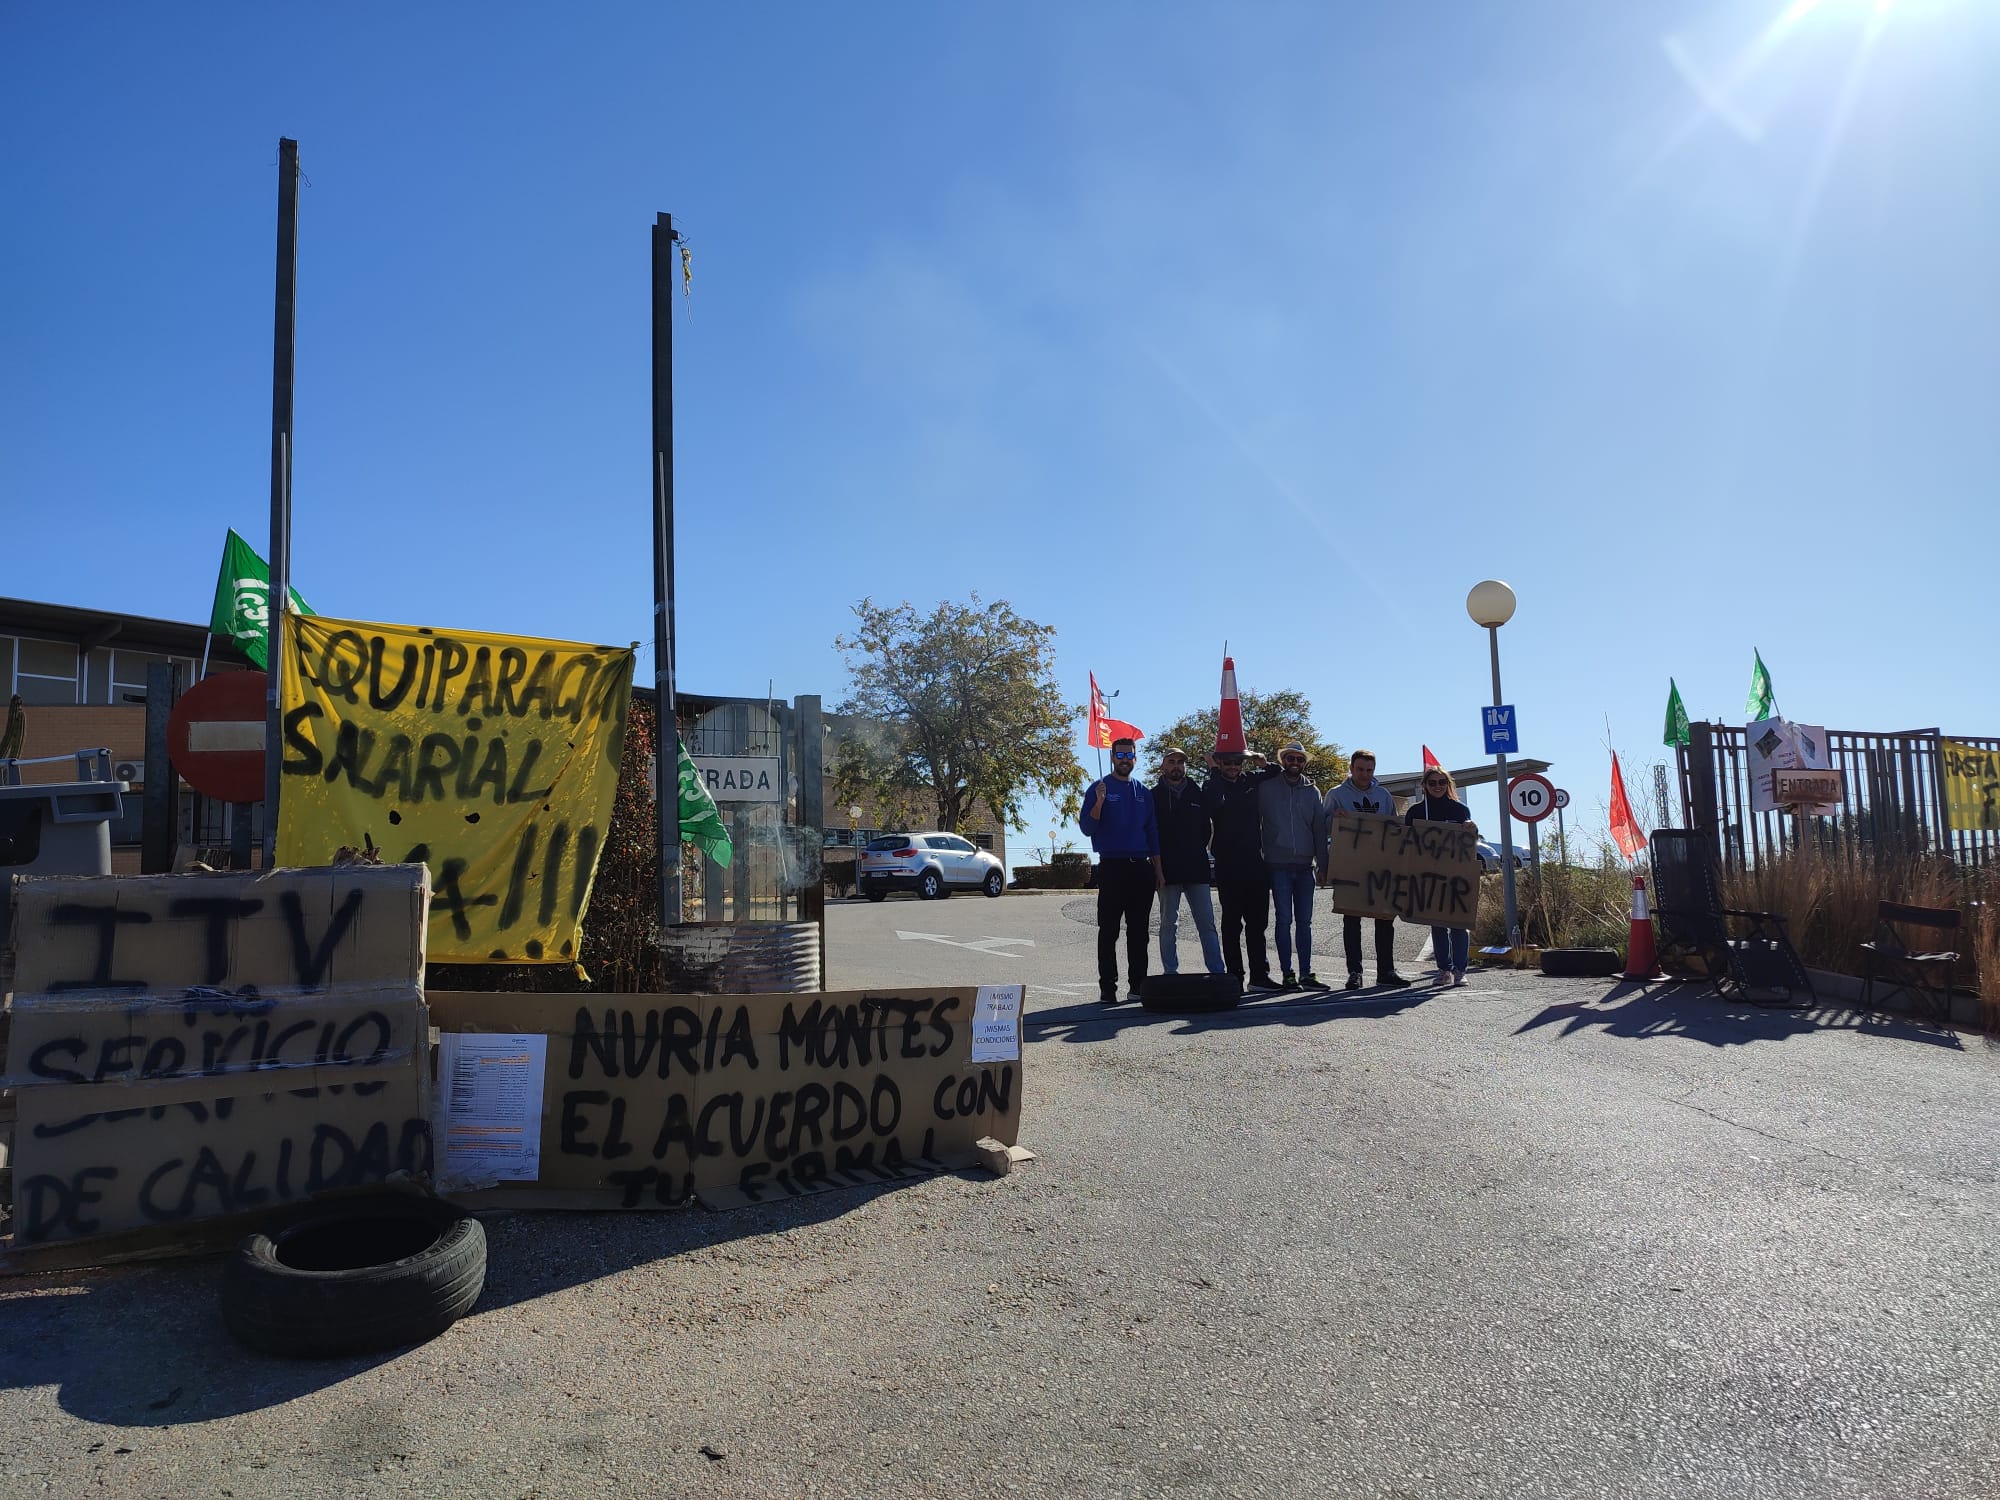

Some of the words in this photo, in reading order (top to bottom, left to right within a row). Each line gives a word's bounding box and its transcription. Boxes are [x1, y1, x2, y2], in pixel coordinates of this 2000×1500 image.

[282, 700, 551, 805] SALARIAL
[1943, 750, 1998, 778] HASTA
[1519, 789, 1541, 806] 10
[1780, 778, 1837, 793] ENTRADA
[1381, 819, 1476, 863] PAGAR
[1366, 870, 1471, 918] MENTIR
[45, 888, 365, 992] ITV
[568, 1005, 760, 1080] NURIA
[778, 997, 960, 1071] MONTES
[559, 1089, 634, 1160] EL
[653, 1074, 902, 1163] ACUERDO
[933, 1067, 1012, 1121] CON
[20, 1166, 118, 1242] DE
[138, 1117, 434, 1222] CALIDAD
[606, 1165, 696, 1209] TU
